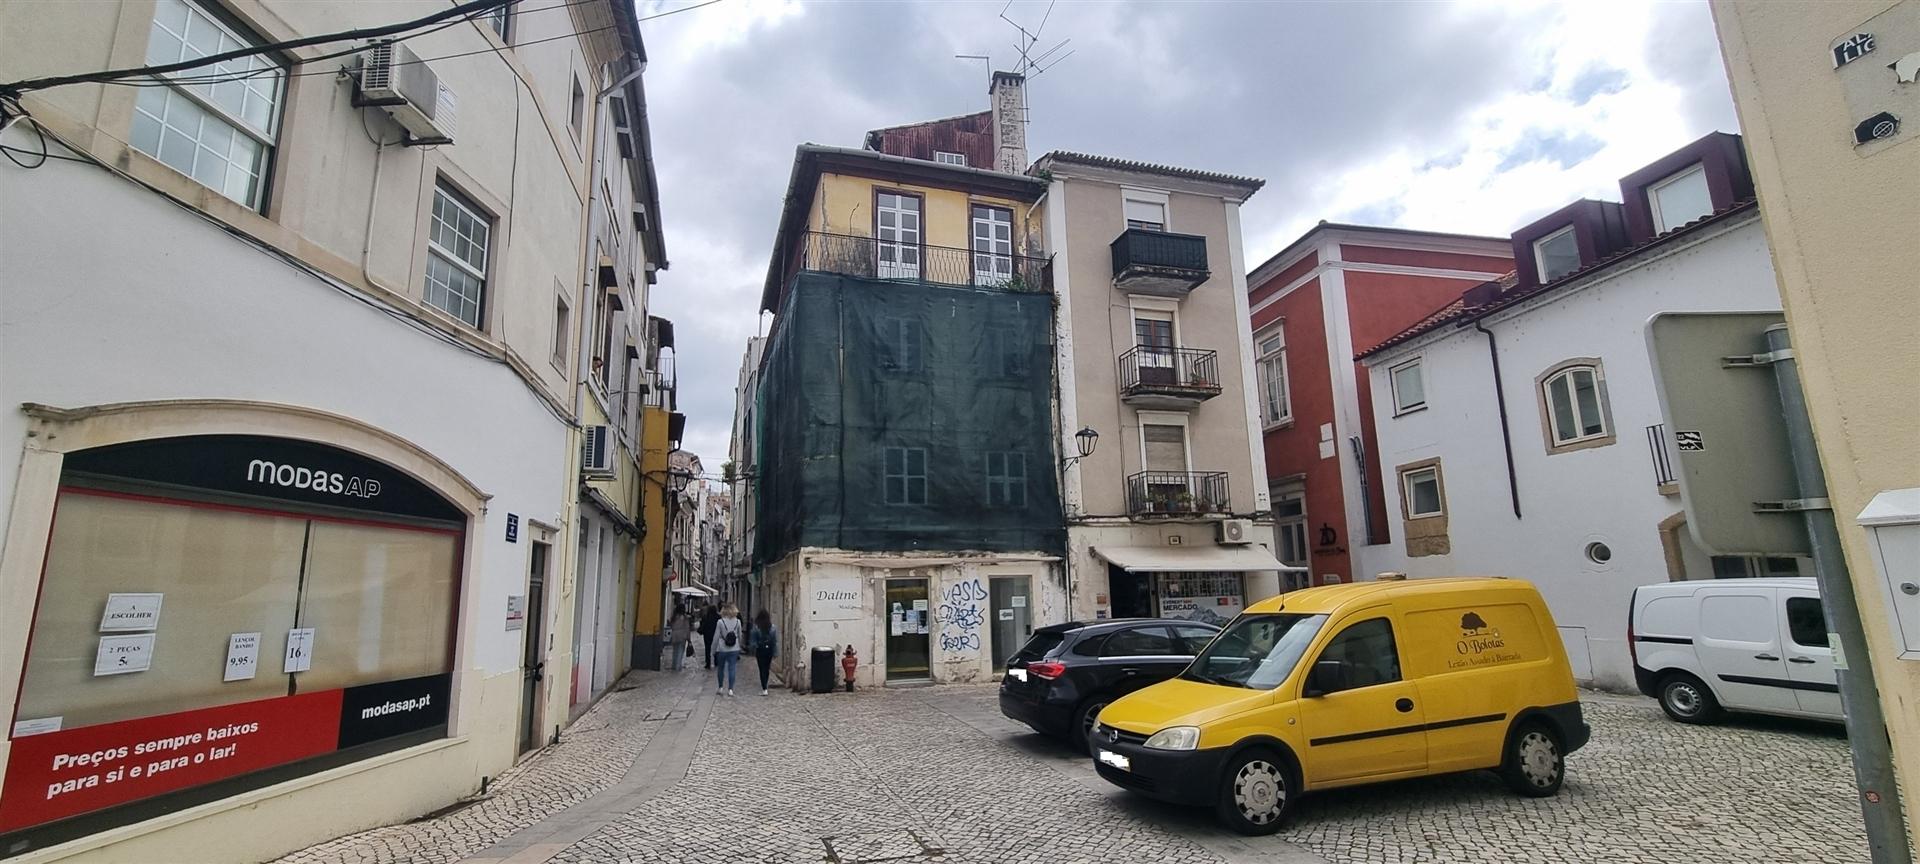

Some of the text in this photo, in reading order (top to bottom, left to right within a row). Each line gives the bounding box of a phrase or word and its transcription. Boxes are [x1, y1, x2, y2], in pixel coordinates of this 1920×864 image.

[1457, 641, 1468, 655] O
[362, 693, 431, 719] modasap.pt
[52, 722, 259, 771] Preços sempre baixos
[47, 743, 237, 800] para si e para o lar!
